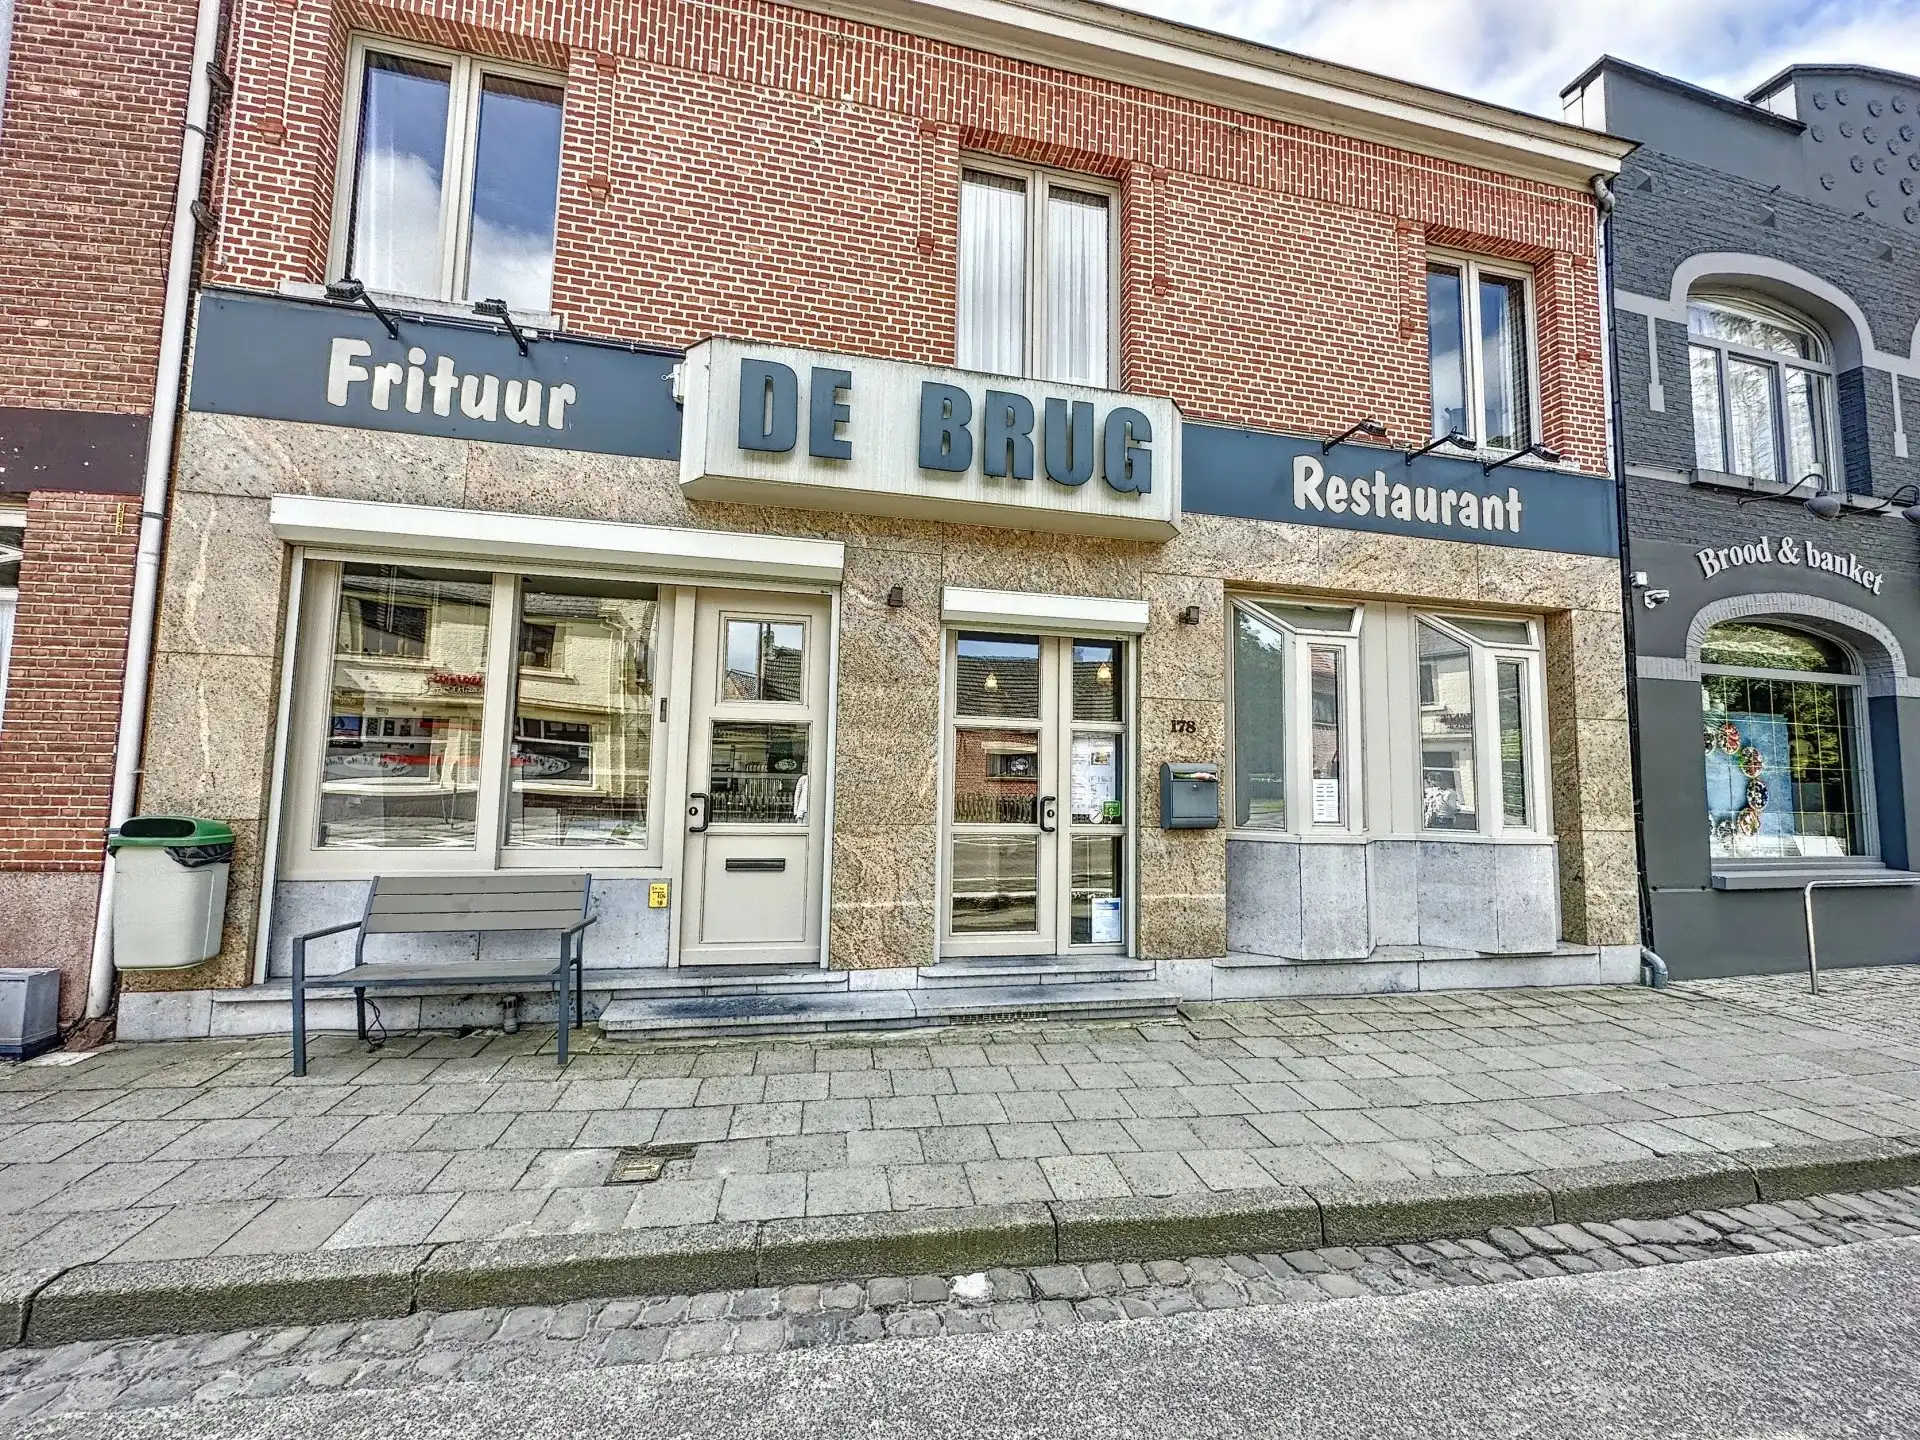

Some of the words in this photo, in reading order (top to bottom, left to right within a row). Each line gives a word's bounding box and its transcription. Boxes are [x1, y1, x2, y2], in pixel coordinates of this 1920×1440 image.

[327, 337, 577, 430] Frituur
[738, 357, 852, 460] DE
[918, 381, 1153, 495] BRUG
[1292, 454, 1522, 533] Restaurant
[1696, 536, 1773, 580] Brood
[1777, 536, 1801, 565] &
[1804, 540, 1884, 596] banket
[1170, 719, 1197, 734] 178
